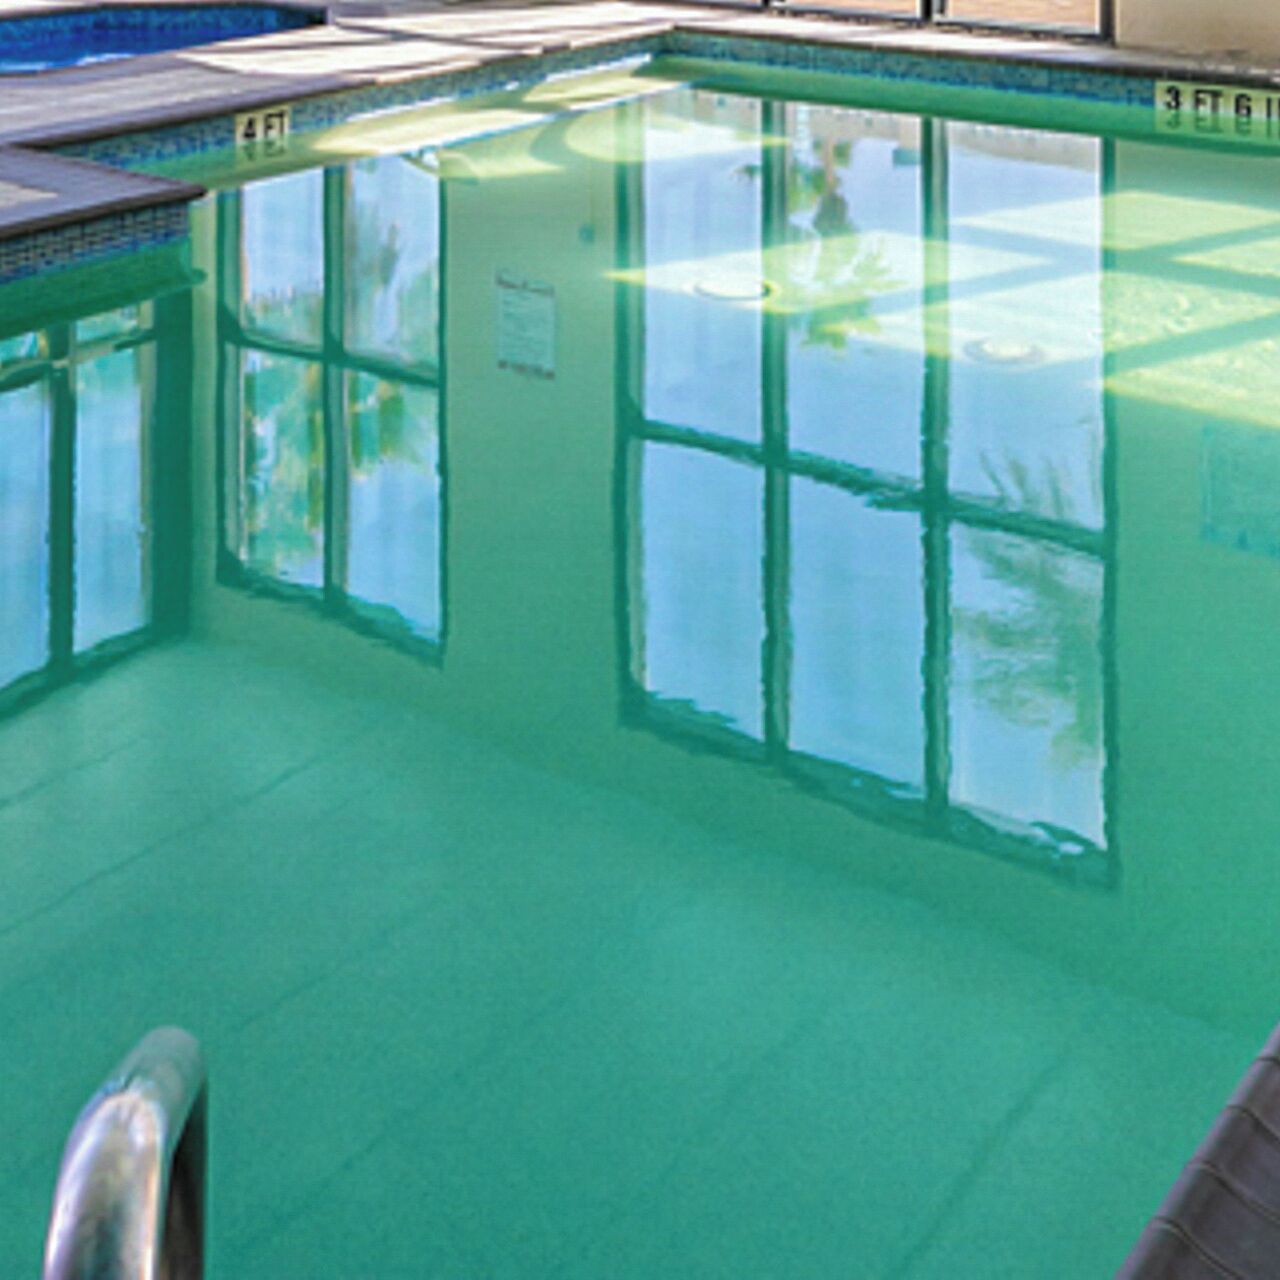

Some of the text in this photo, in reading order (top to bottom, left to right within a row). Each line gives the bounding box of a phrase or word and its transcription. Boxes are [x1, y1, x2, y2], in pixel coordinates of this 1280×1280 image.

[1165, 85, 1181, 111] 3
[1194, 89, 1223, 112] FT
[1235, 93, 1252, 118] 6
[243, 109, 285, 139] 4 FT
